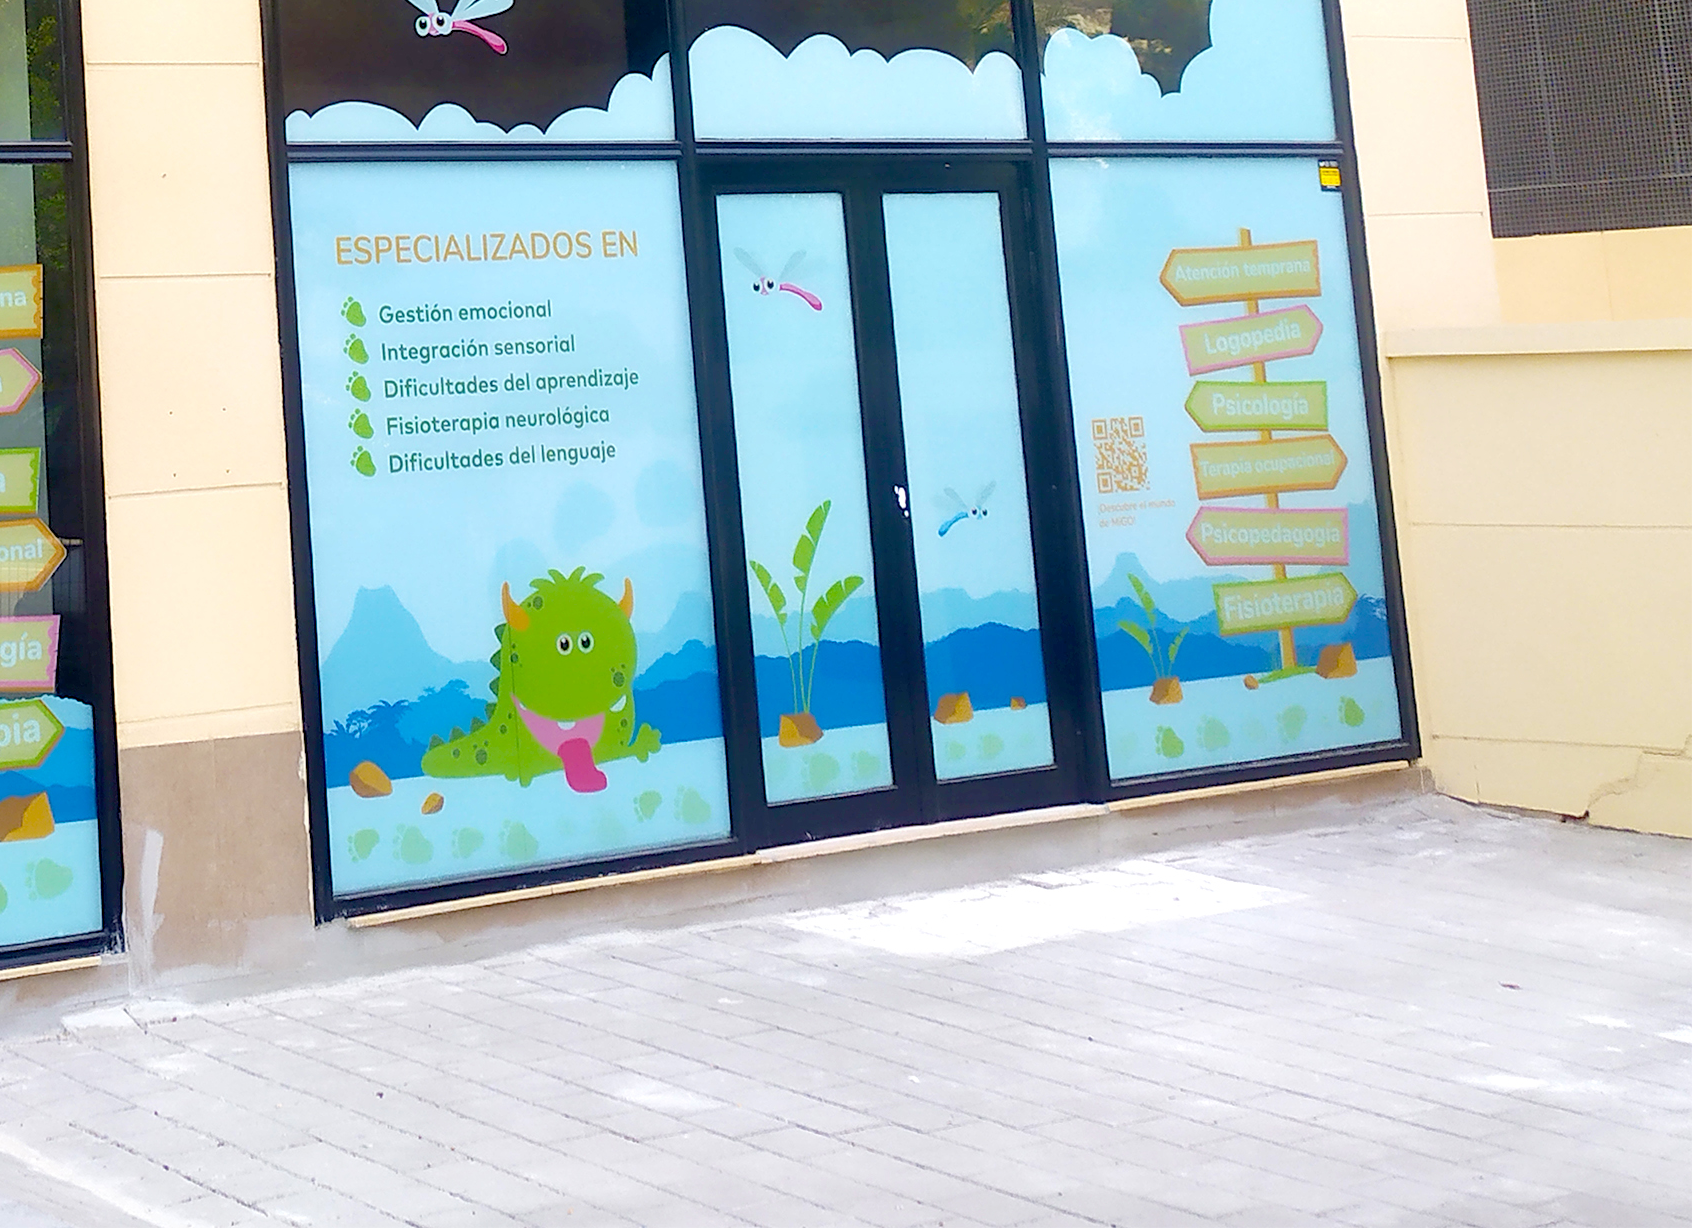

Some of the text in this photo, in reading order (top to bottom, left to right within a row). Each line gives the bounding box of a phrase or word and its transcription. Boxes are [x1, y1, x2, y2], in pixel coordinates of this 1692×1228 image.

[335, 230, 639, 265] ESPECIALIZADOS EN
[1174, 258, 1311, 282] Atención temprana
[379, 300, 552, 324] Gestión emocional
[381, 334, 576, 364] Integración sensorial
[1204, 318, 1301, 355] Logopedia
[384, 368, 639, 399] Dificultades del aprendizaje
[386, 406, 610, 436] Fisioterapia neurológica
[1212, 392, 1309, 420] Psicología
[389, 440, 616, 474] Dificultades del lenguaje
[1200, 450, 1335, 478] Terapia ocupacional
[1201, 521, 1341, 554] Psicopedagogía
[1223, 584, 1345, 621] Fisioterapia
